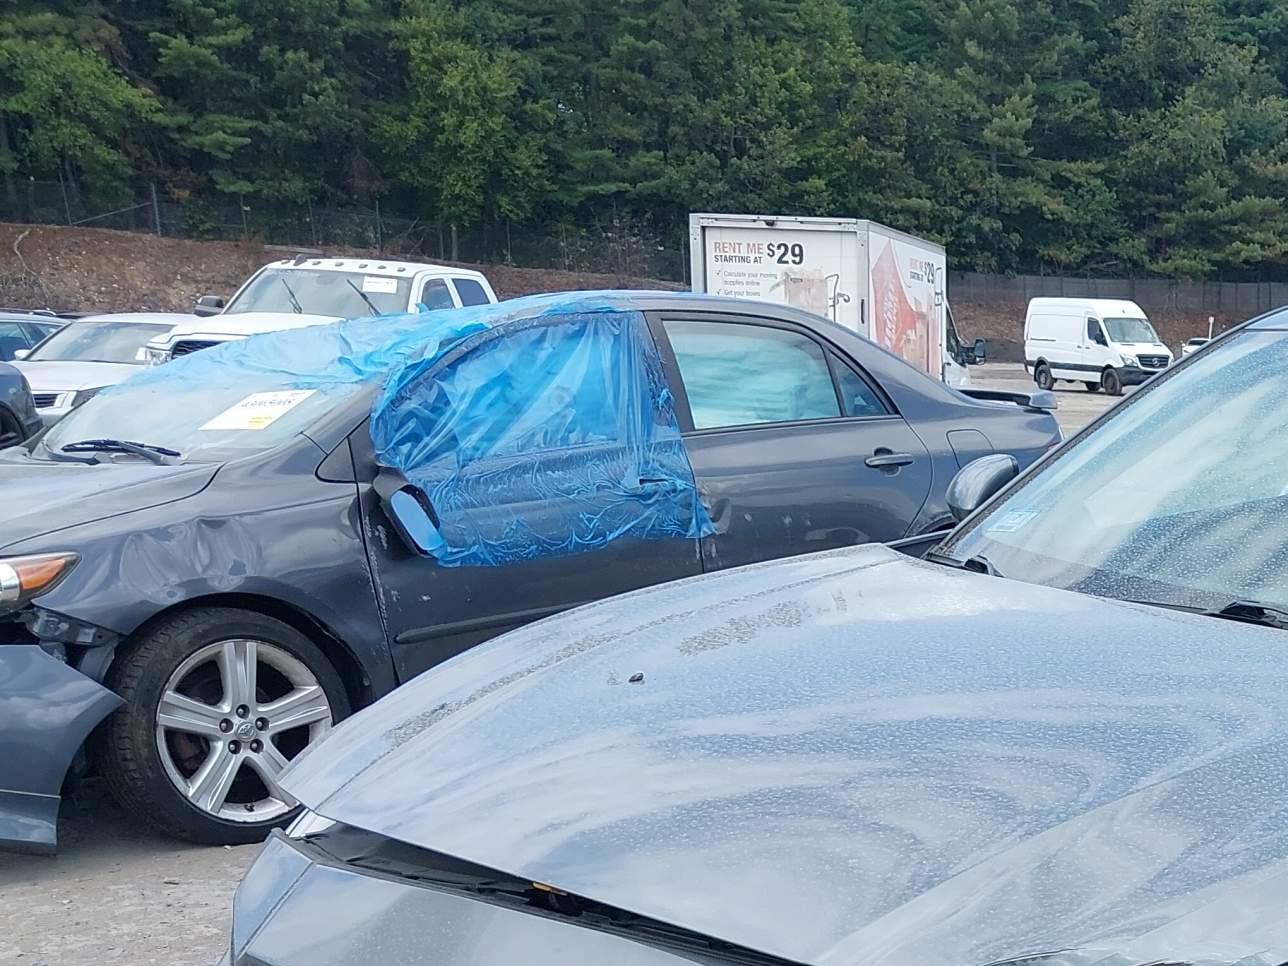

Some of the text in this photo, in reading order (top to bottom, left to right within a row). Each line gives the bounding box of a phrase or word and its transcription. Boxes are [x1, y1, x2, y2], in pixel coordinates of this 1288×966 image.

[714, 242, 764, 255] RENT ME
[766, 242, 804, 265] $29
[714, 255, 763, 264] STARTING AT
